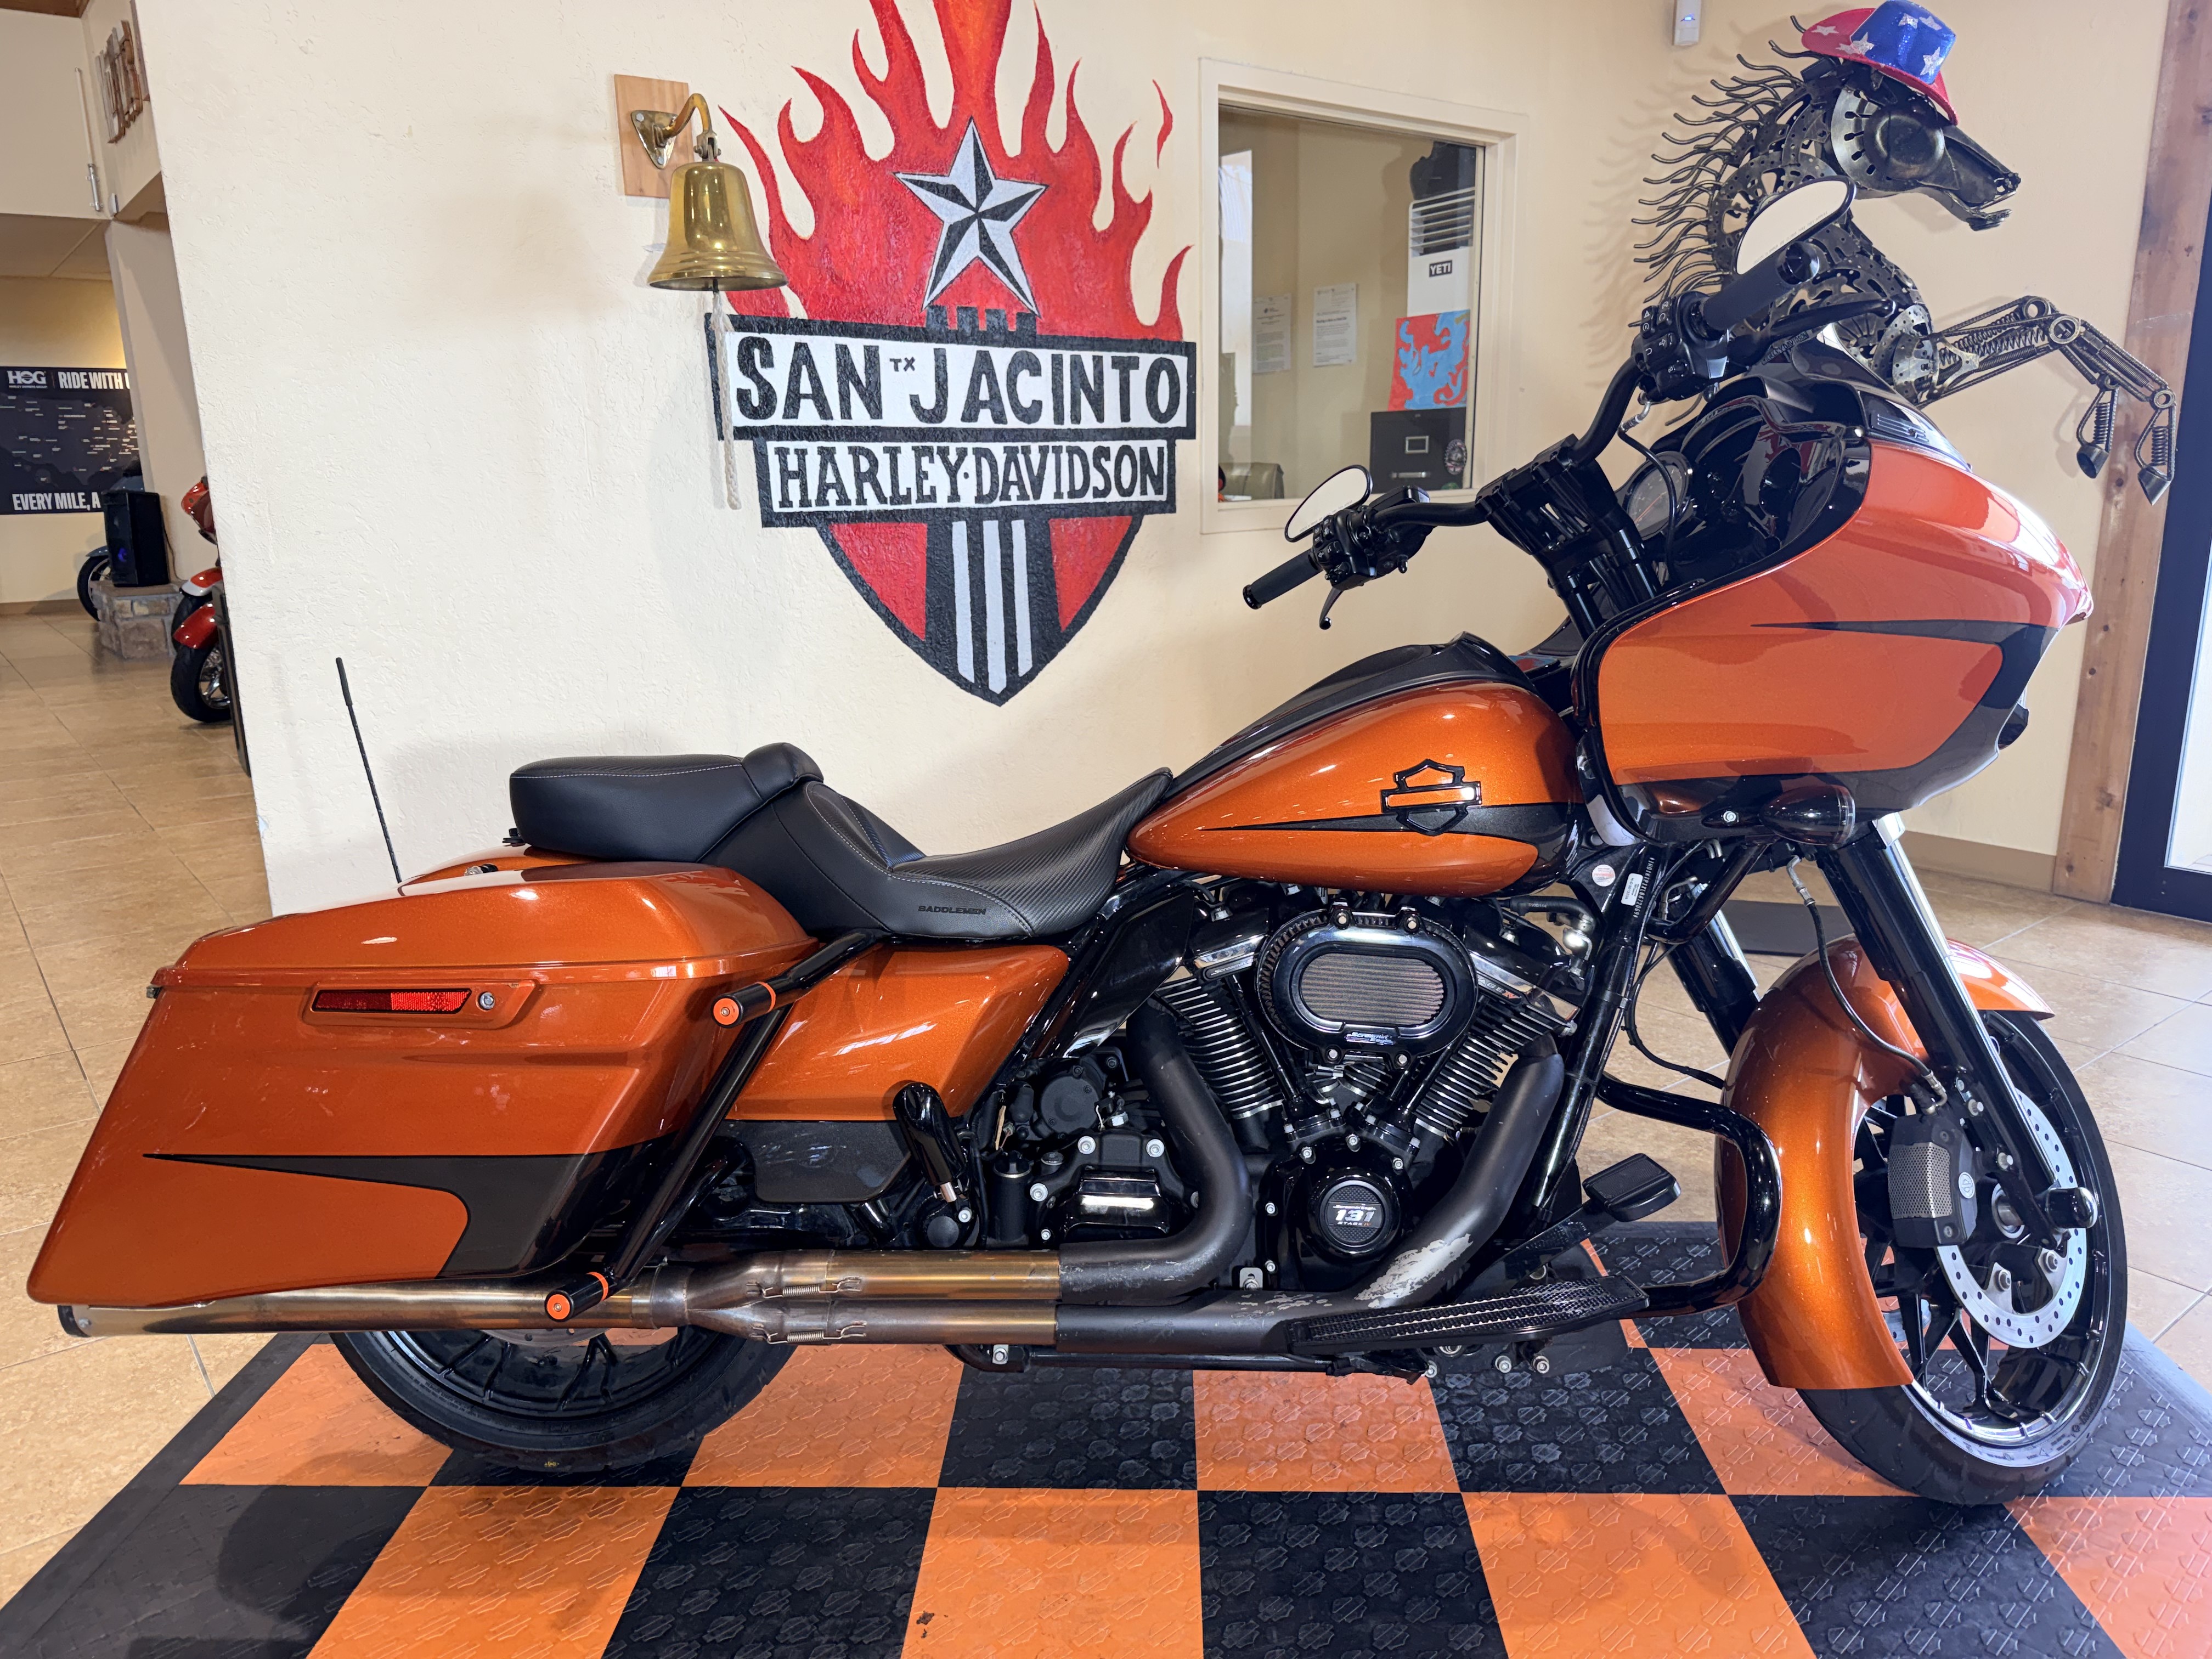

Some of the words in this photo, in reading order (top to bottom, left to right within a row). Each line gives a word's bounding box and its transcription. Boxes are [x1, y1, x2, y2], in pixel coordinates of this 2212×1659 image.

[1430, 263, 1451, 275] YETI
[7, 371, 47, 384] HOG
[58, 371, 89, 389] RIDE
[88, 372, 124, 390] WITH
[736, 336, 883, 420] SAN
[890, 357, 916, 372] TX
[909, 348, 1180, 425] JACINTO
[12, 493, 52, 510] EVERY
[54, 492, 91, 511] MILE,
[918, 906, 986, 915] SADDLEMEN
[1478, 979, 1504, 993] AGE
[1335, 1210, 1375, 1222] 131
